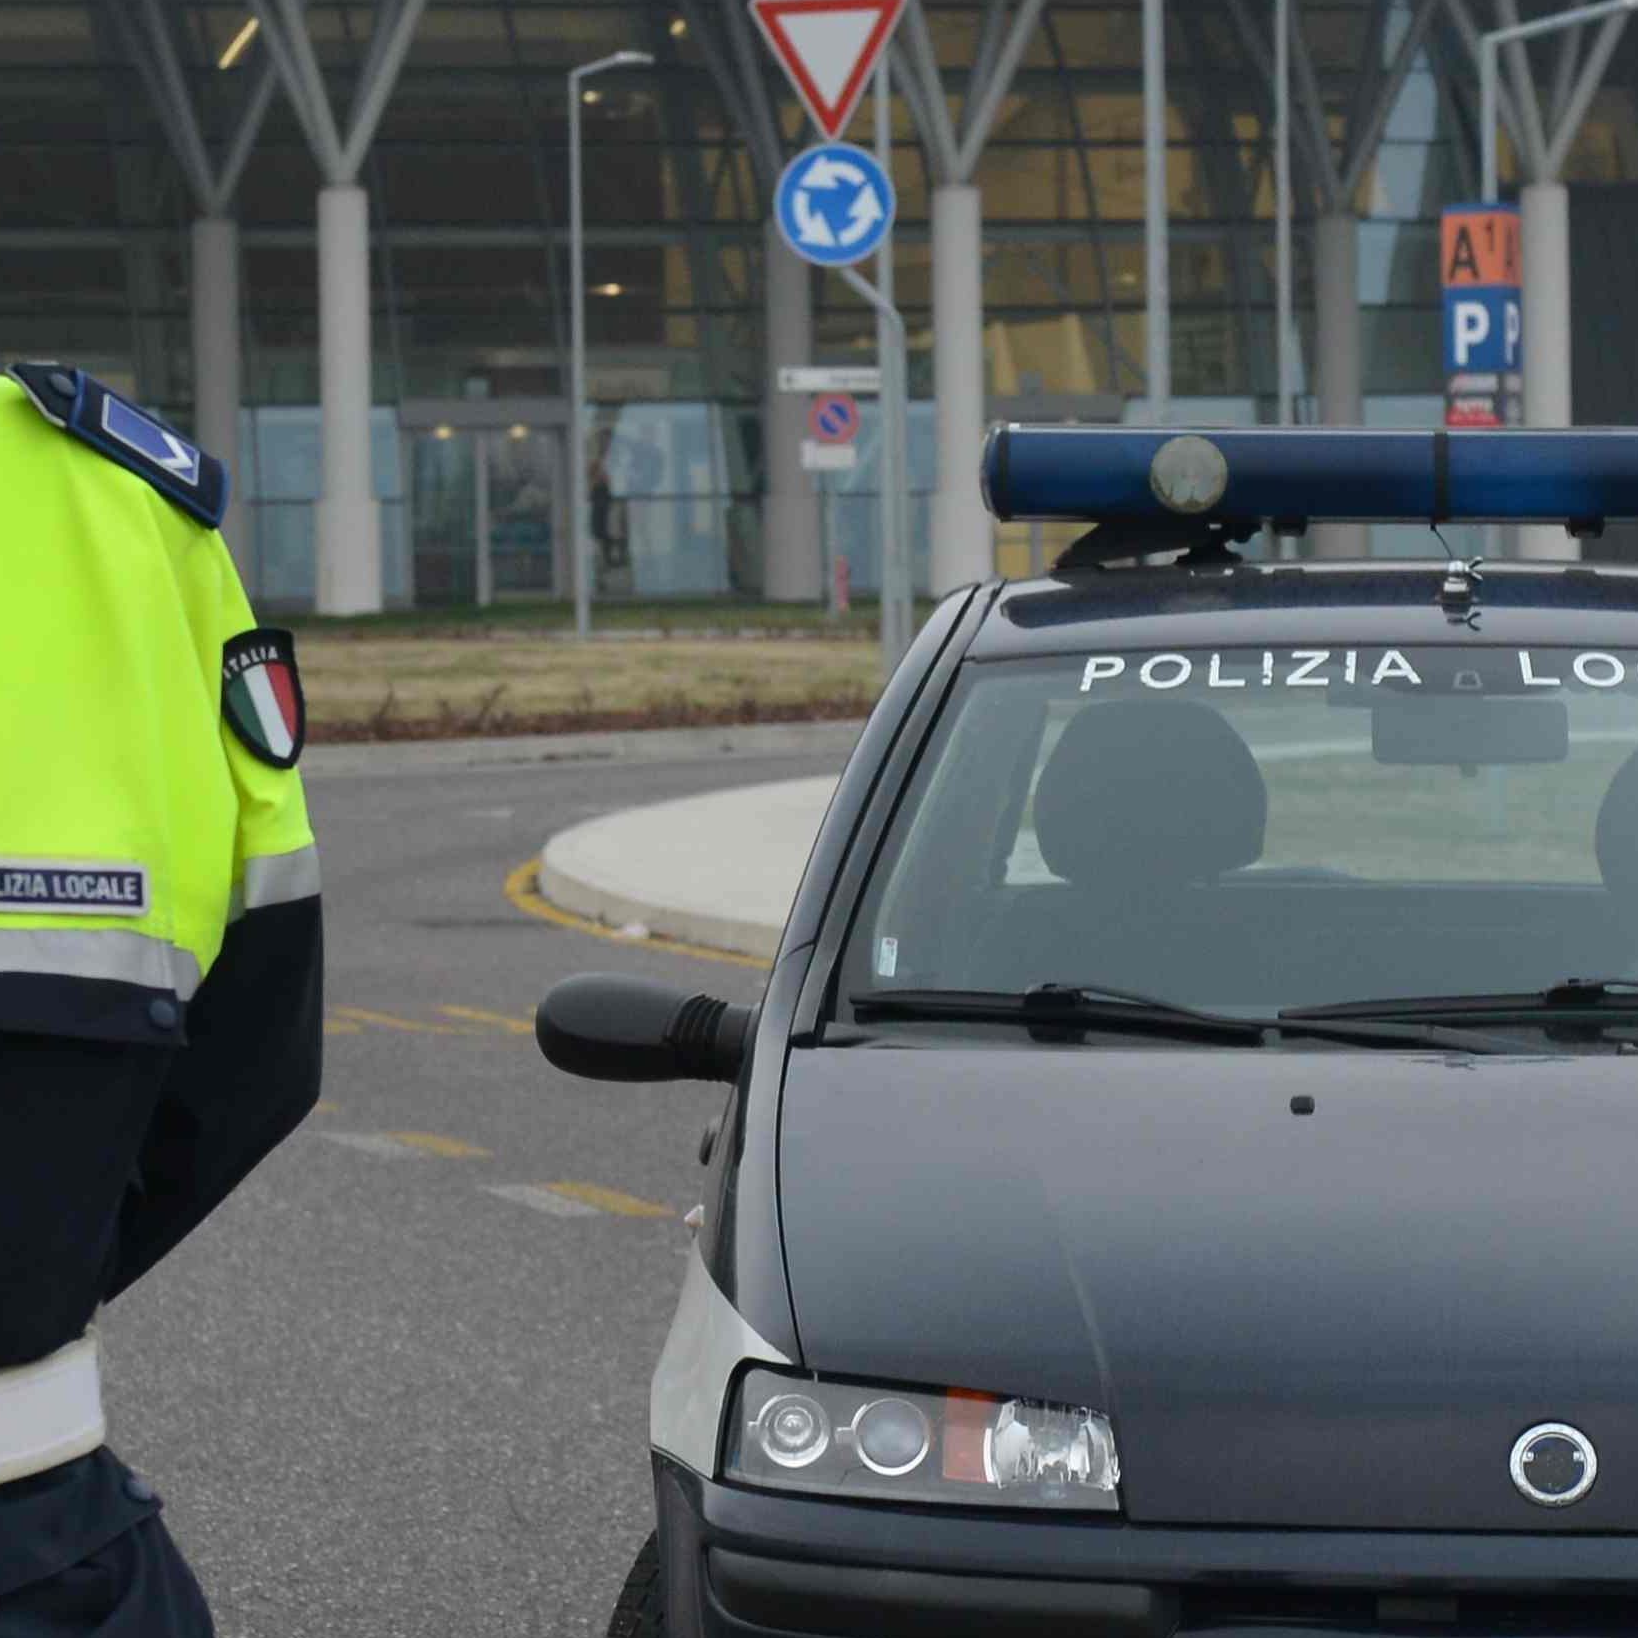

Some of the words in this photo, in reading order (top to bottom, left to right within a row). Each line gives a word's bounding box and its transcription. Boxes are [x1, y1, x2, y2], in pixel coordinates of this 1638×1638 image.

[1454, 300, 1491, 366] P
[223, 646, 279, 679] ITALIA
[1079, 649, 1423, 692] POLIZIA
[52, 873, 138, 901] LOCALE
